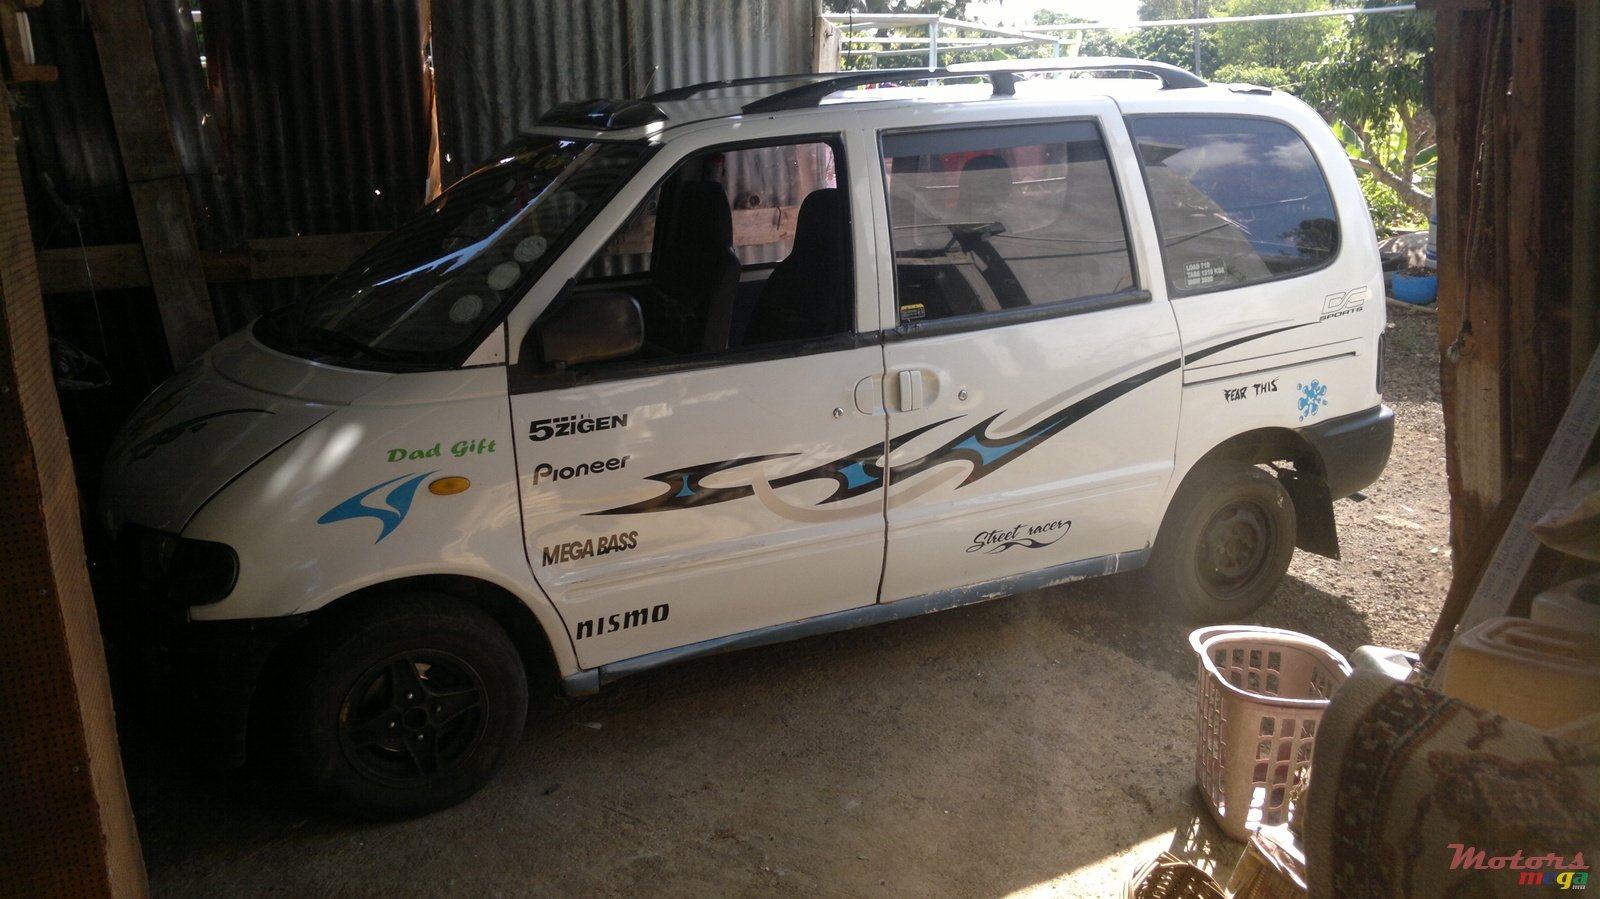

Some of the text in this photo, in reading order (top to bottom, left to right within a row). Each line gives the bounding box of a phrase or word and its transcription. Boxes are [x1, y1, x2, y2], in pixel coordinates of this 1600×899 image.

[1319, 306, 1363, 323] SPORTS
[1321, 285, 1367, 315] DC
[1224, 376, 1279, 404] FEAR THIS
[386, 438, 496, 462] Dad Gift
[532, 455, 630, 486] Pioneer
[542, 530, 638, 567] MEGA BASS
[965, 519, 1072, 553] Street racer
